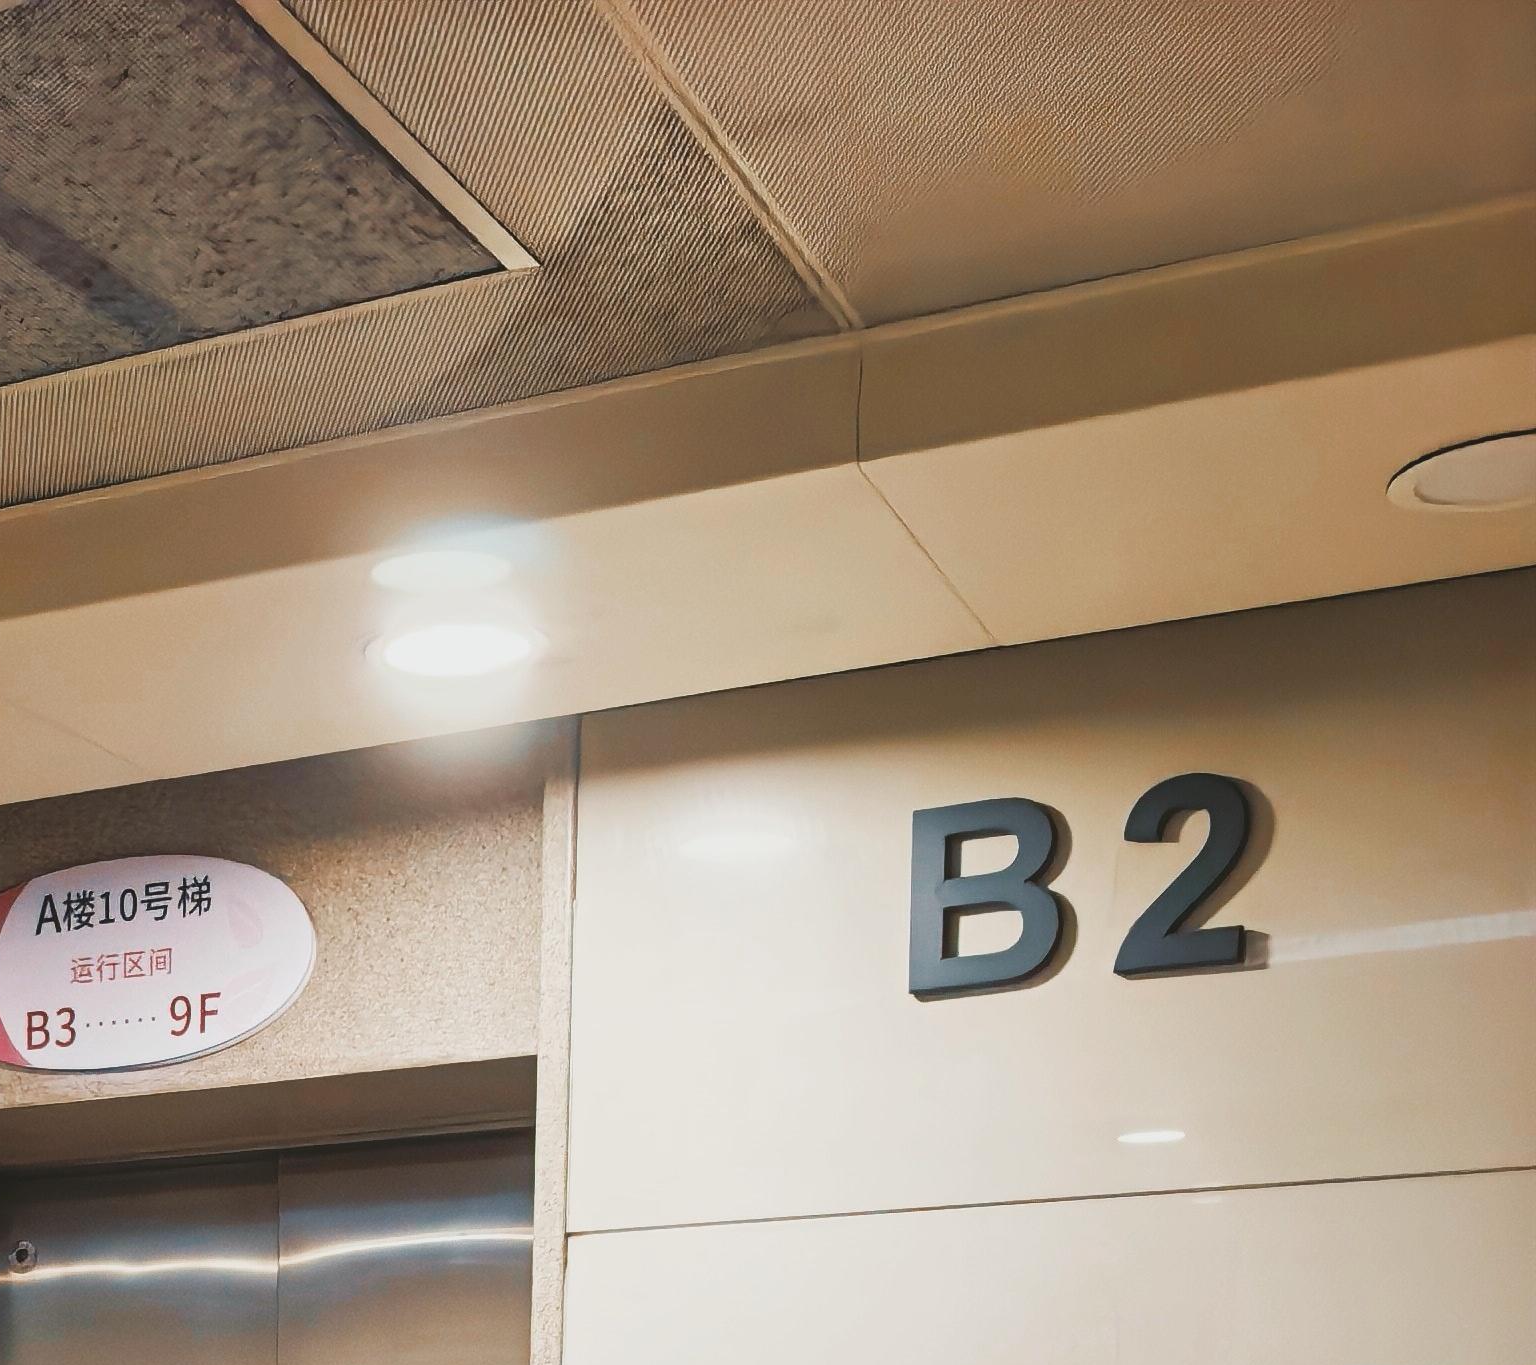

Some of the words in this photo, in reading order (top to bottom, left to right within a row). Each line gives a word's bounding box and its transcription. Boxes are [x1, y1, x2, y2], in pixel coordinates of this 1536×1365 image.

[36, 875, 213, 936] A楼10号梯
[70, 948, 173, 984] 运行区间
